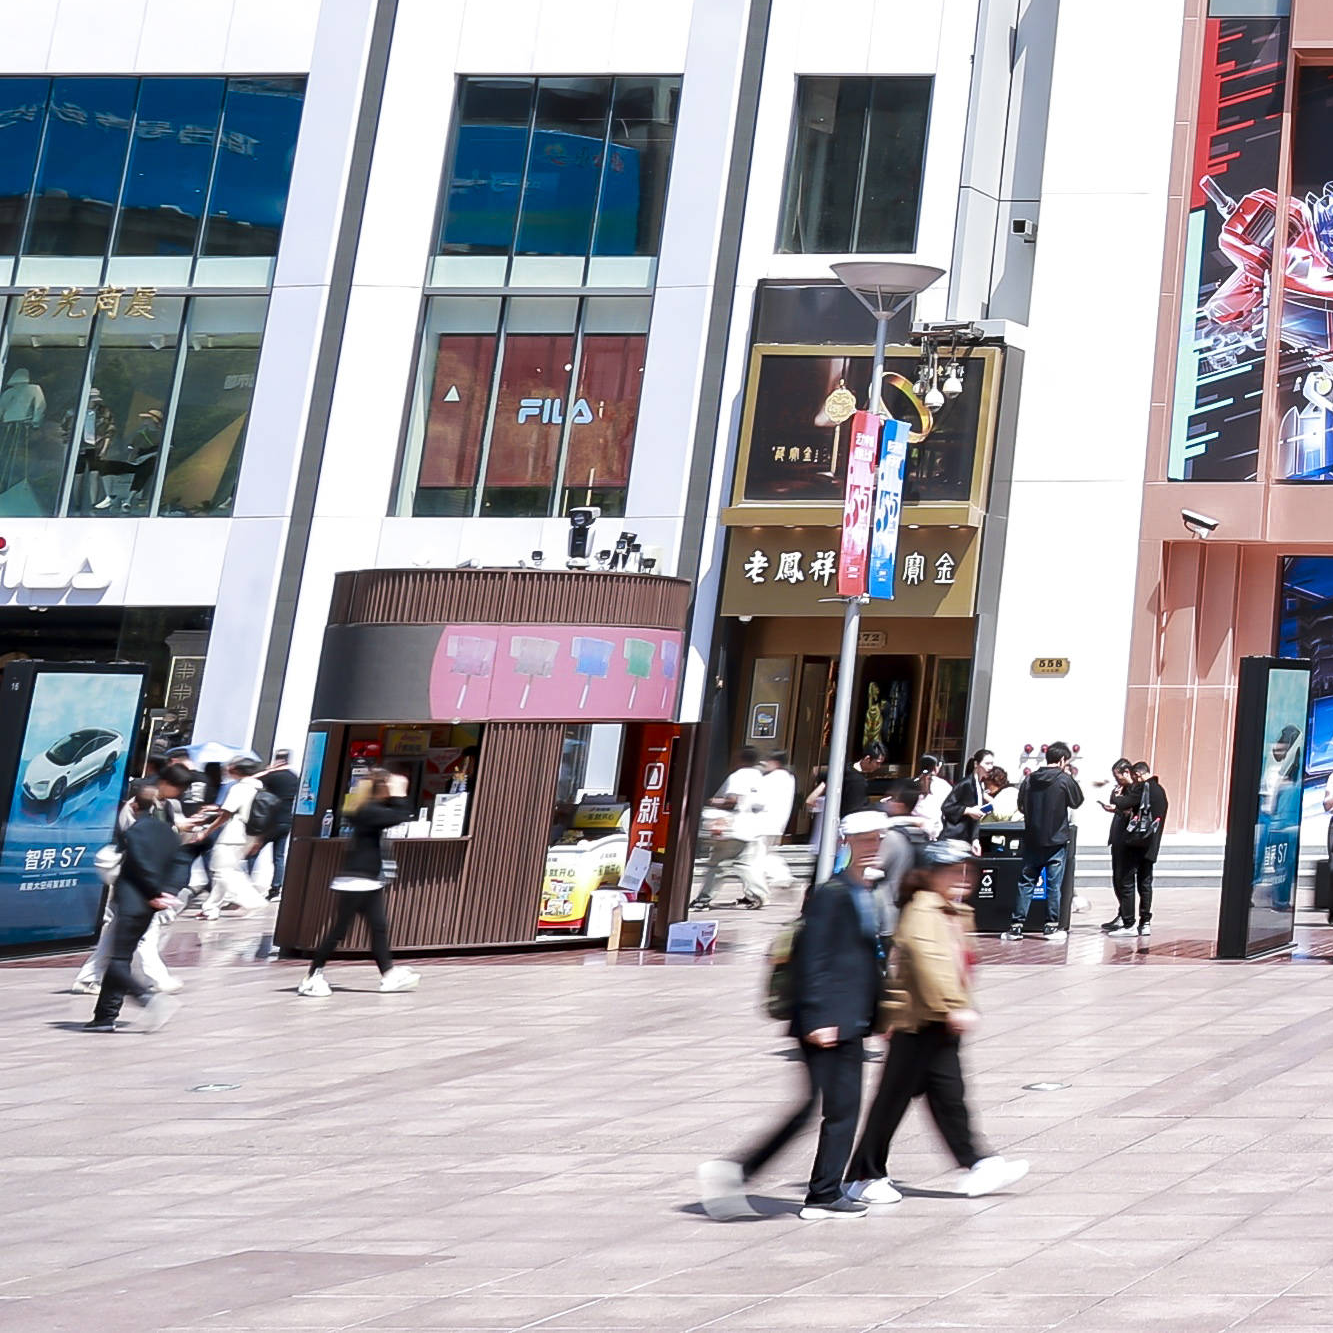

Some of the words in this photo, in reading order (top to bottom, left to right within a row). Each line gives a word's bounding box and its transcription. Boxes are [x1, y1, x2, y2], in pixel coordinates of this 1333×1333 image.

[518, 398, 593, 424] FILA
[25, 849, 57, 871] 智界
[60, 846, 86, 868] S7
